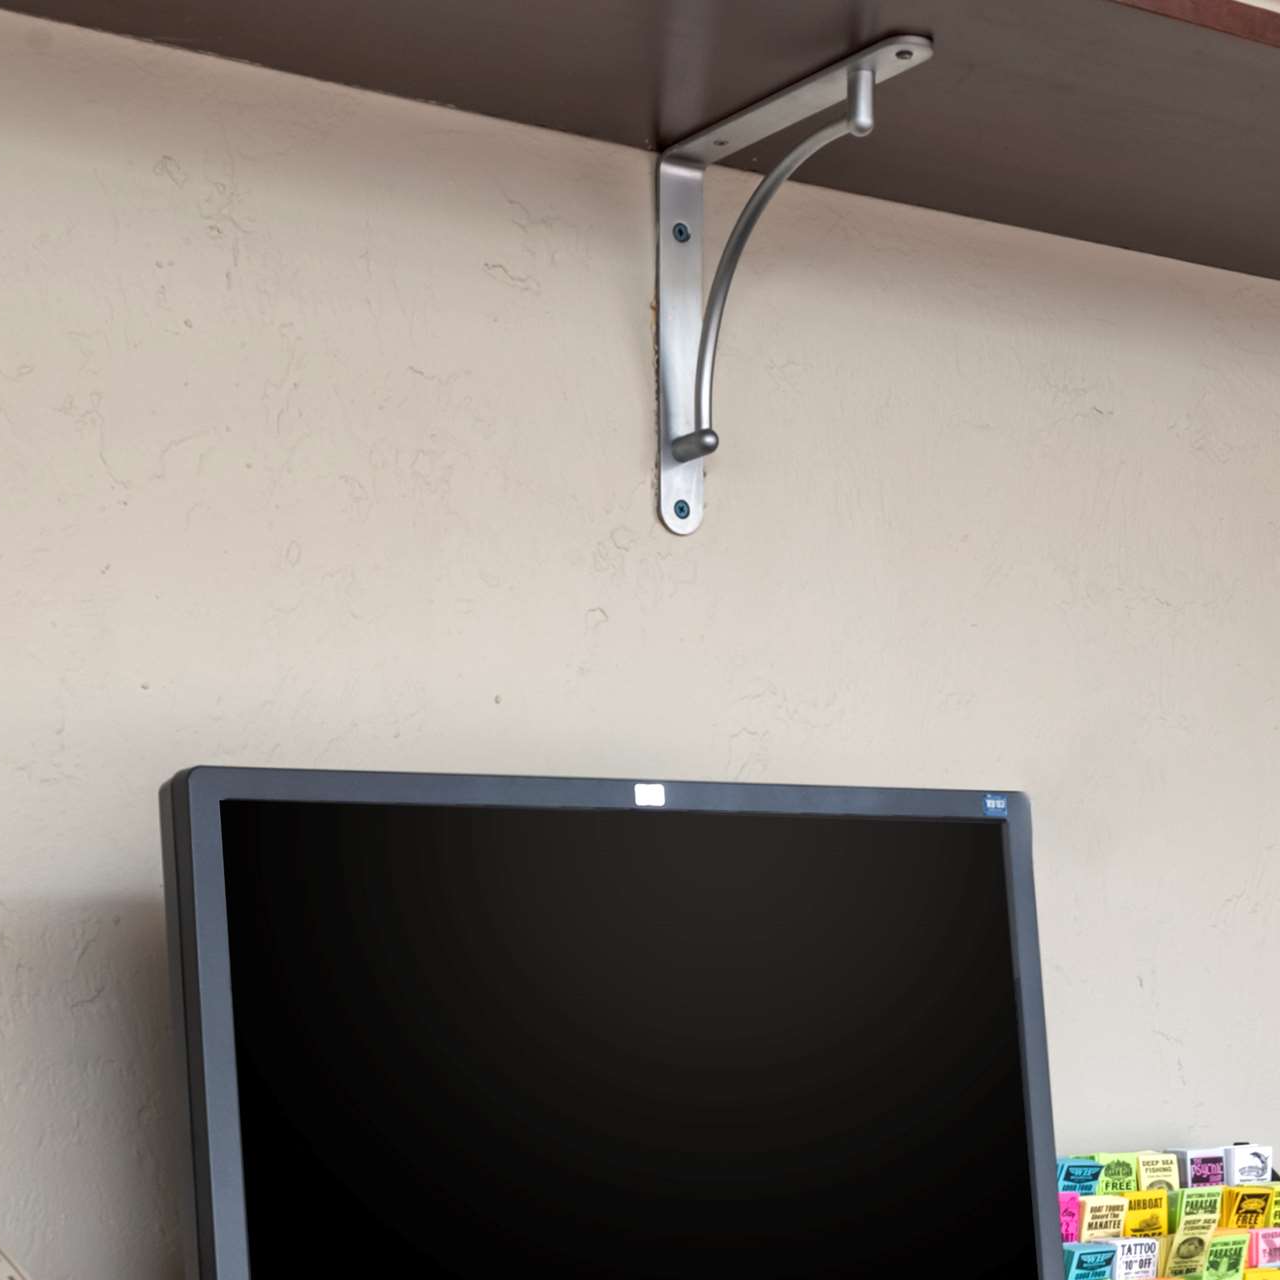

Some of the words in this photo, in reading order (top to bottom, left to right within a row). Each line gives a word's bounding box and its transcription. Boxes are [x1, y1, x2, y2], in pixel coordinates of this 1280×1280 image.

[1105, 1182, 1132, 1191] FREE
[1090, 1205, 1104, 1213] BOAT
[1105, 1204, 1124, 1212] TOURS
[1128, 1197, 1163, 1211] AIRBOAT
[1087, 1219, 1122, 1231] MANATEE
[1236, 1214, 1259, 1225] FREE
[1121, 1242, 1156, 1256] TATTOO
[1139, 1258, 1152, 1269] OFF
